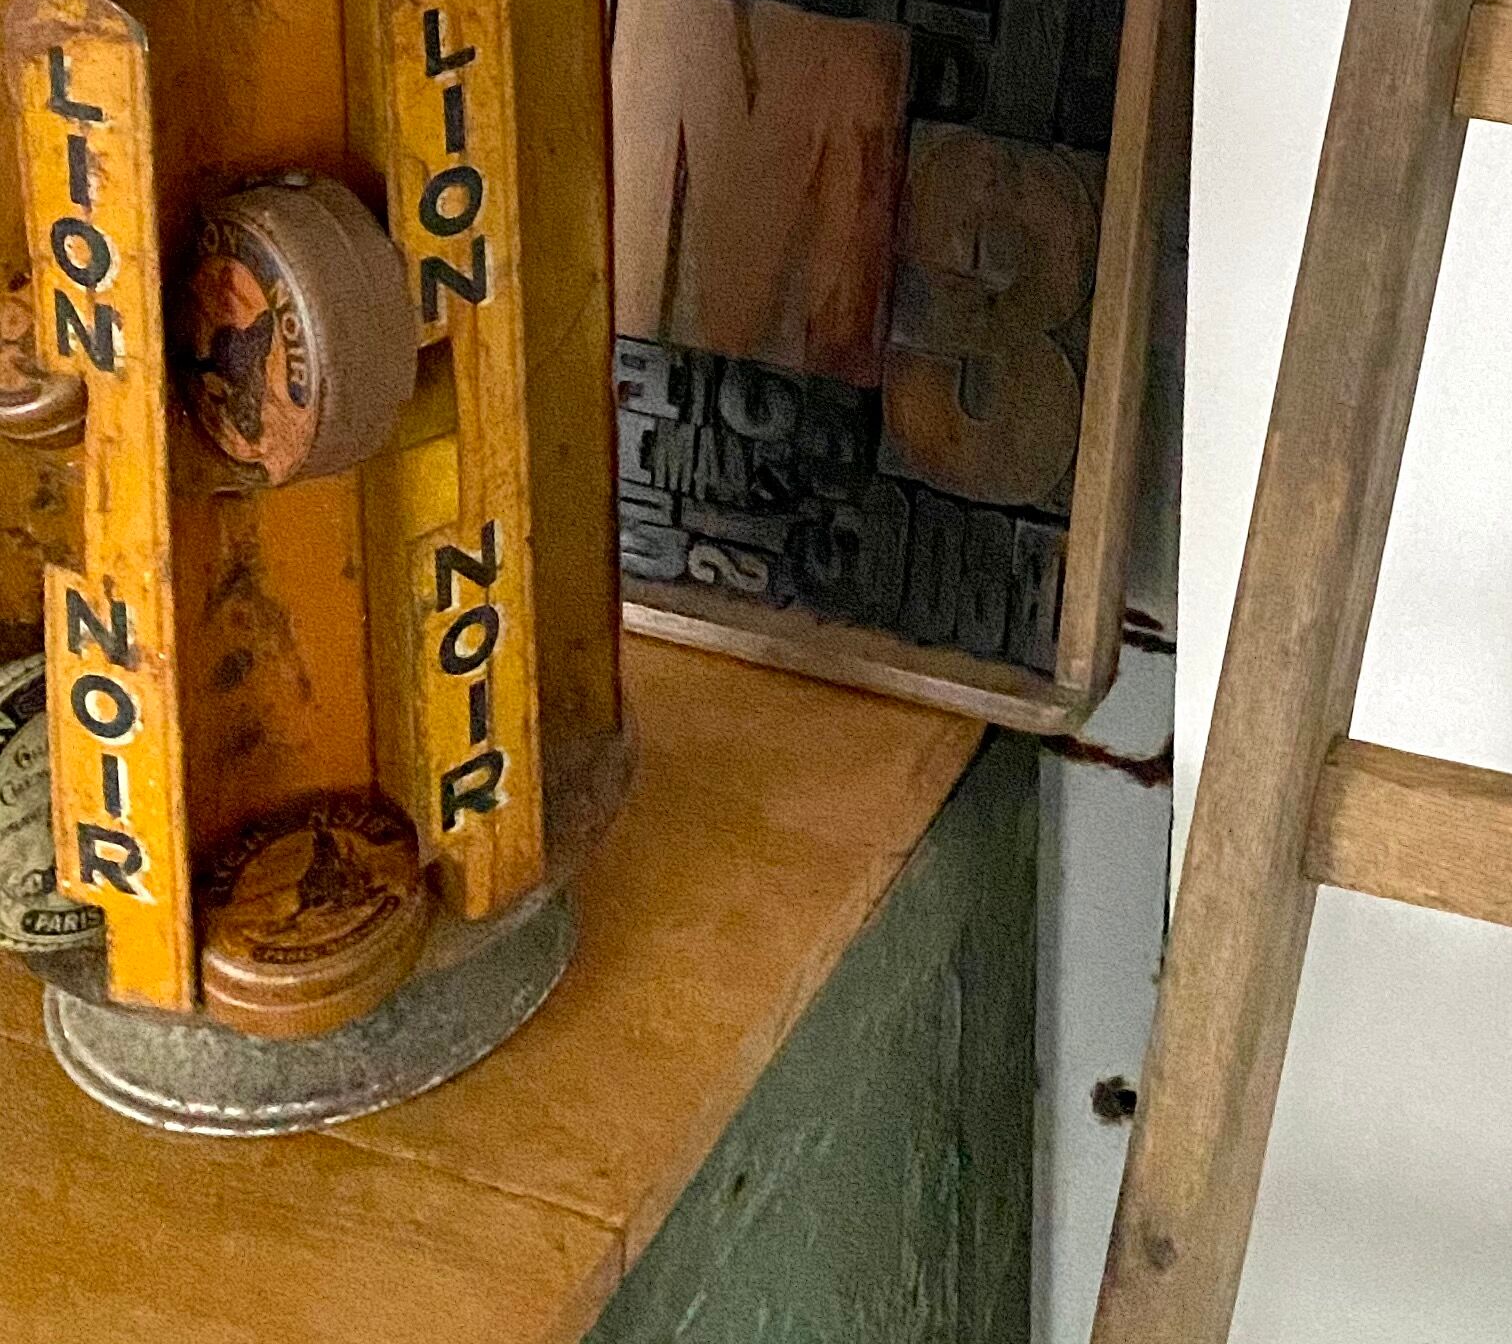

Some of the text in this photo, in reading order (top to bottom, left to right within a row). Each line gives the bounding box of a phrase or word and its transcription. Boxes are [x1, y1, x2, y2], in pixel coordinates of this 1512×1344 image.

[48, 45, 144, 897] LION NOIR
[420, 9, 504, 832] LION NOIR
